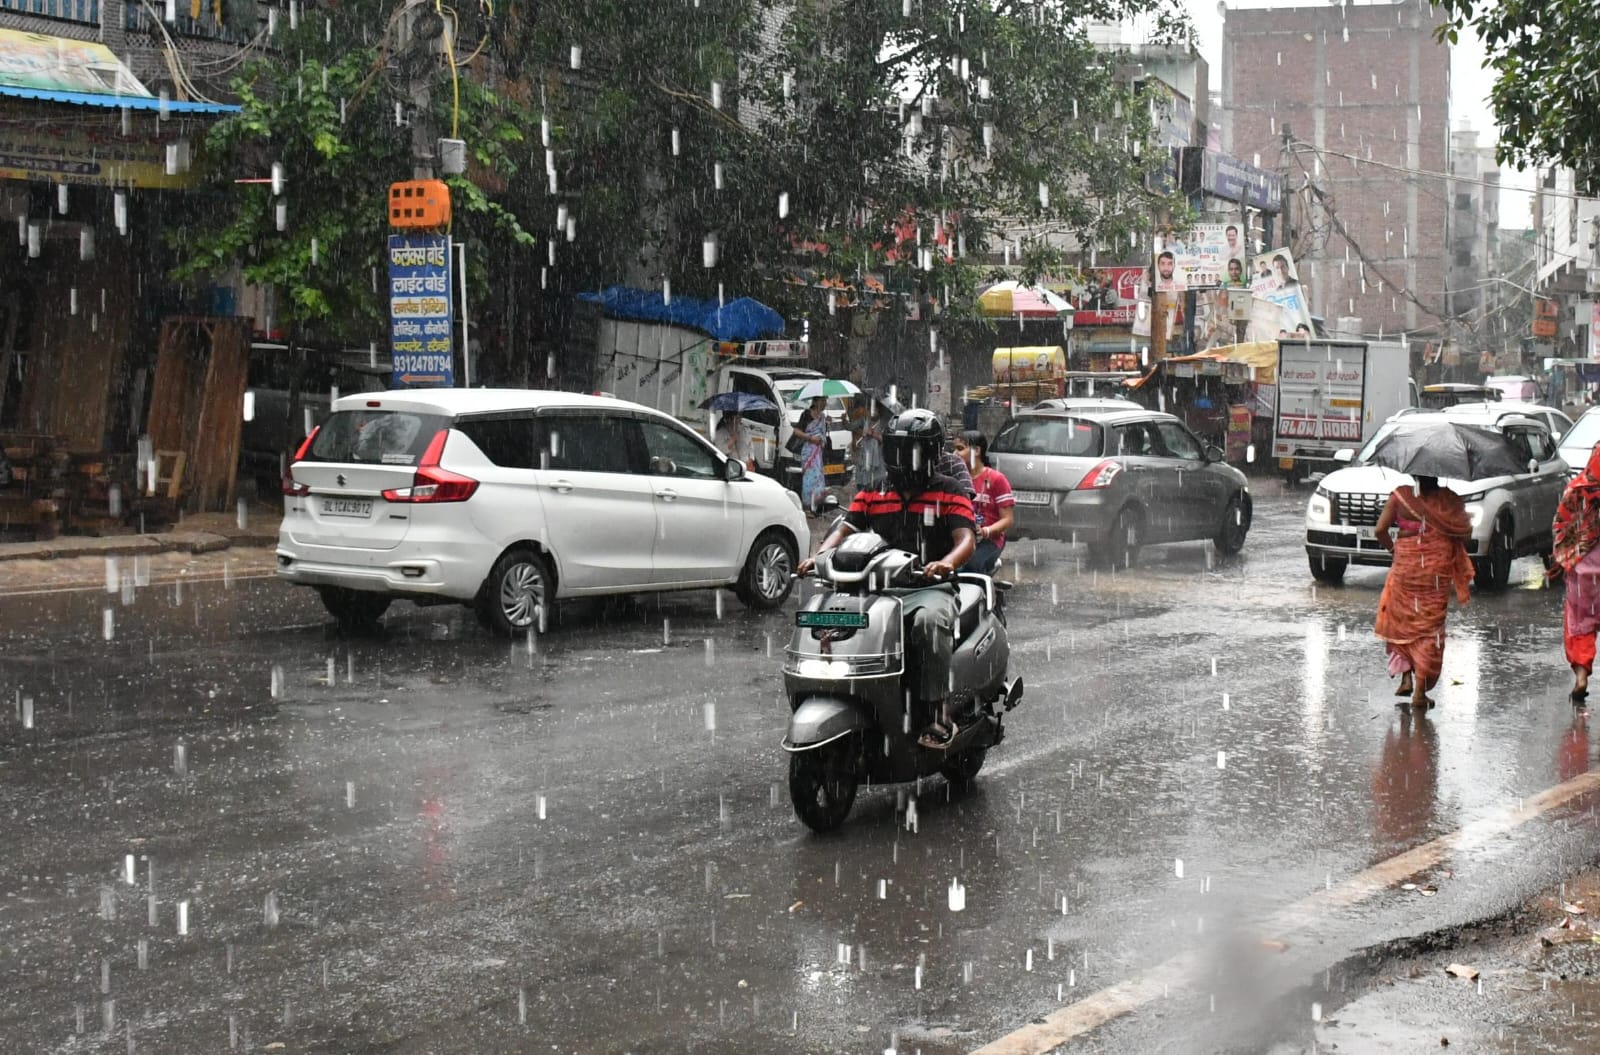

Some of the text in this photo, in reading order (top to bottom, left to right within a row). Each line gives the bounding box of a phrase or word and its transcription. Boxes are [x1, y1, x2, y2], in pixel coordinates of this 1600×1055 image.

[426, 239, 445, 267] बोर्ड
[392, 270, 447, 294] लाईट बोर्ड
[394, 355, 451, 372] 9312478794
[1281, 420, 1358, 438] BLOW HORN
